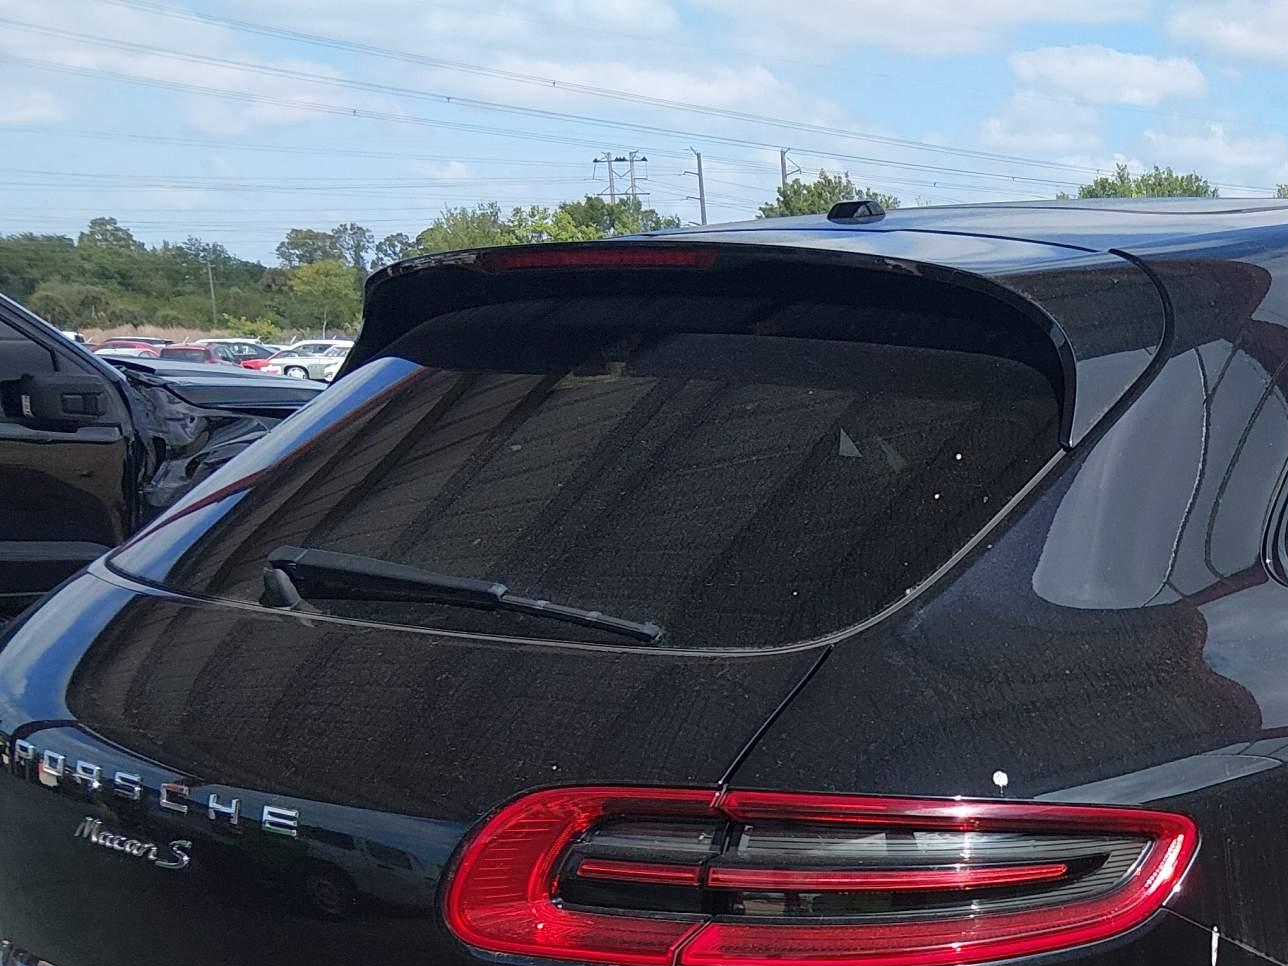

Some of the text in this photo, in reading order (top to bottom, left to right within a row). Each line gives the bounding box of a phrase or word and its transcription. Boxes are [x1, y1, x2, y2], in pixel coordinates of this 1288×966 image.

[15, 738, 300, 837] PORSCHE
[73, 816, 192, 869] Macan S
